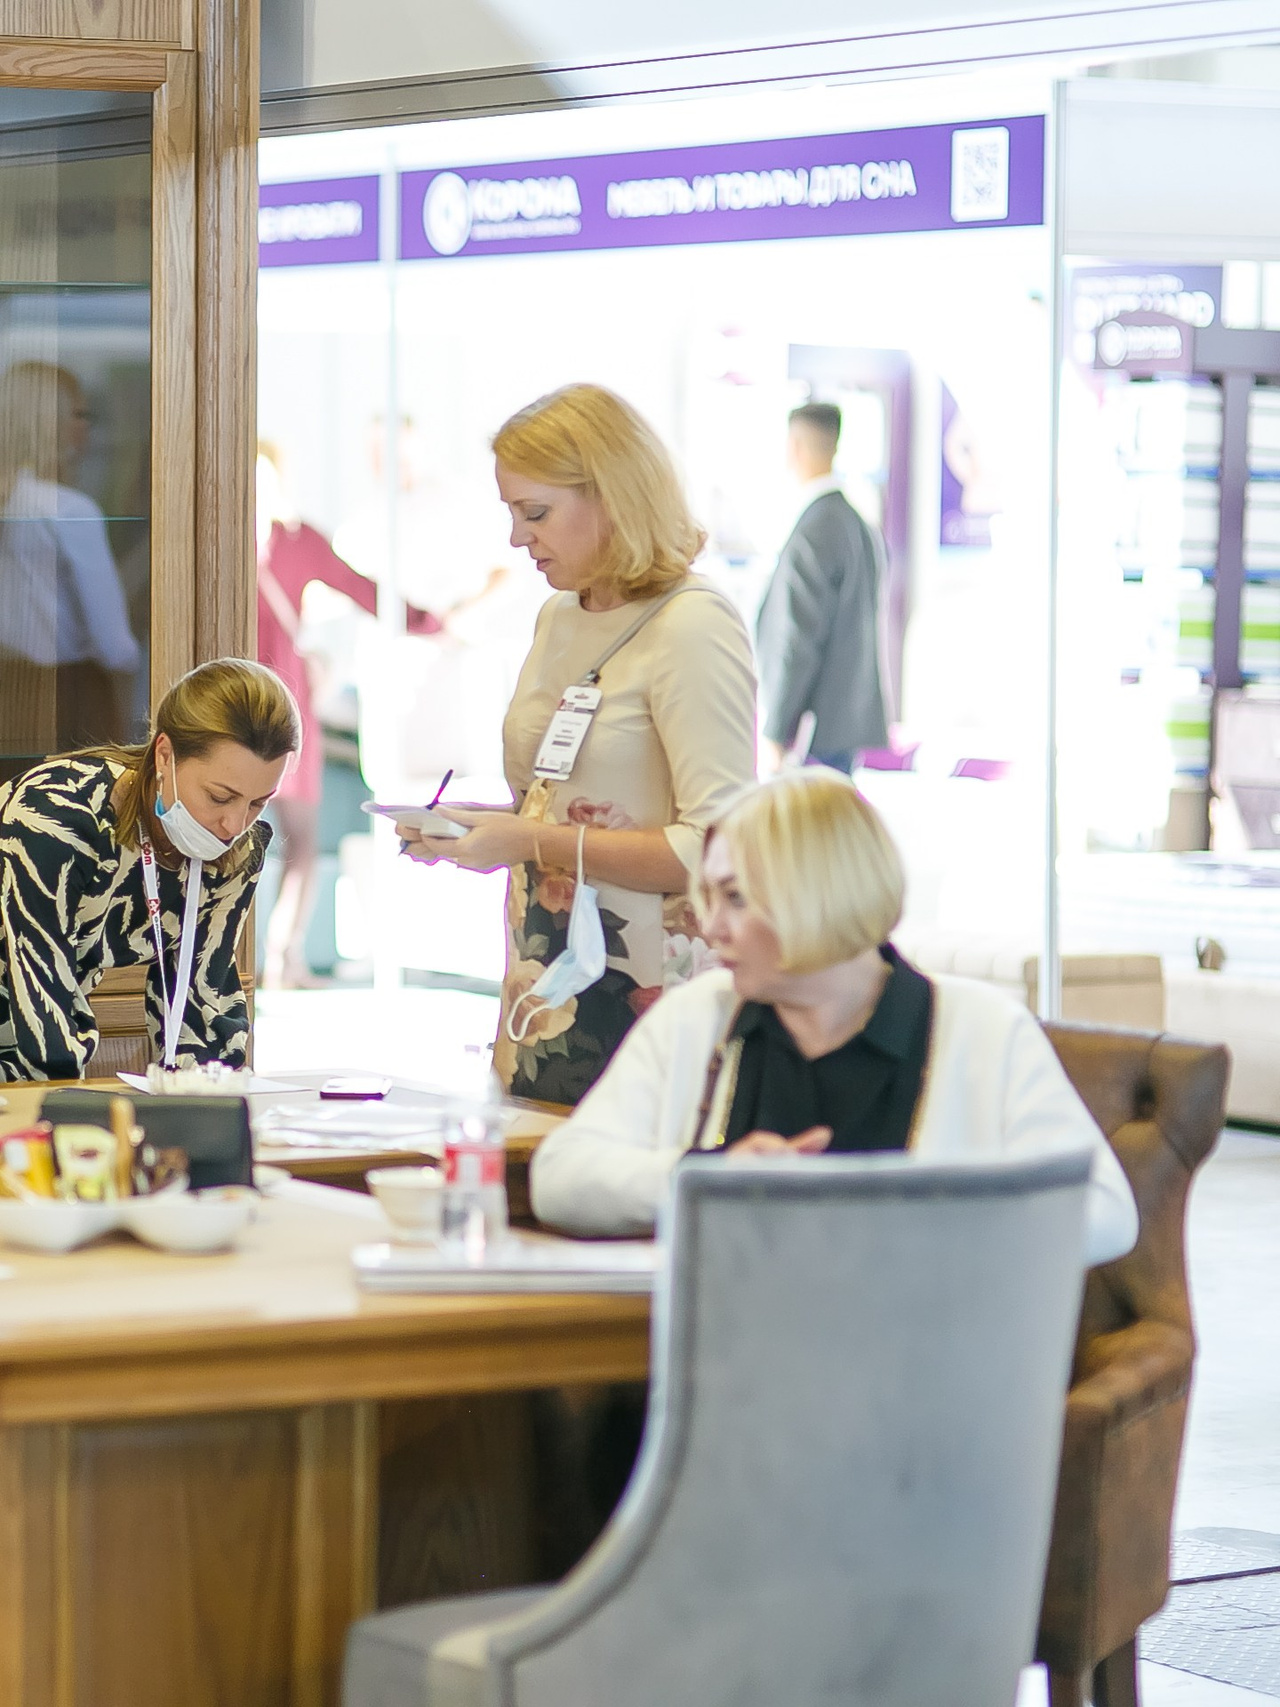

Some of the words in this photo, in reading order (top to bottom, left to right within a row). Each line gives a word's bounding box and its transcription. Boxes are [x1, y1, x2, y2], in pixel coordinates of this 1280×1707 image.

[469, 176, 581, 221] КОРОНА
[692, 174, 716, 212] И
[716, 167, 809, 210] ТОВАРЫ
[809, 164, 862, 208] ДЛЯ
[861, 159, 917, 200] СНА
